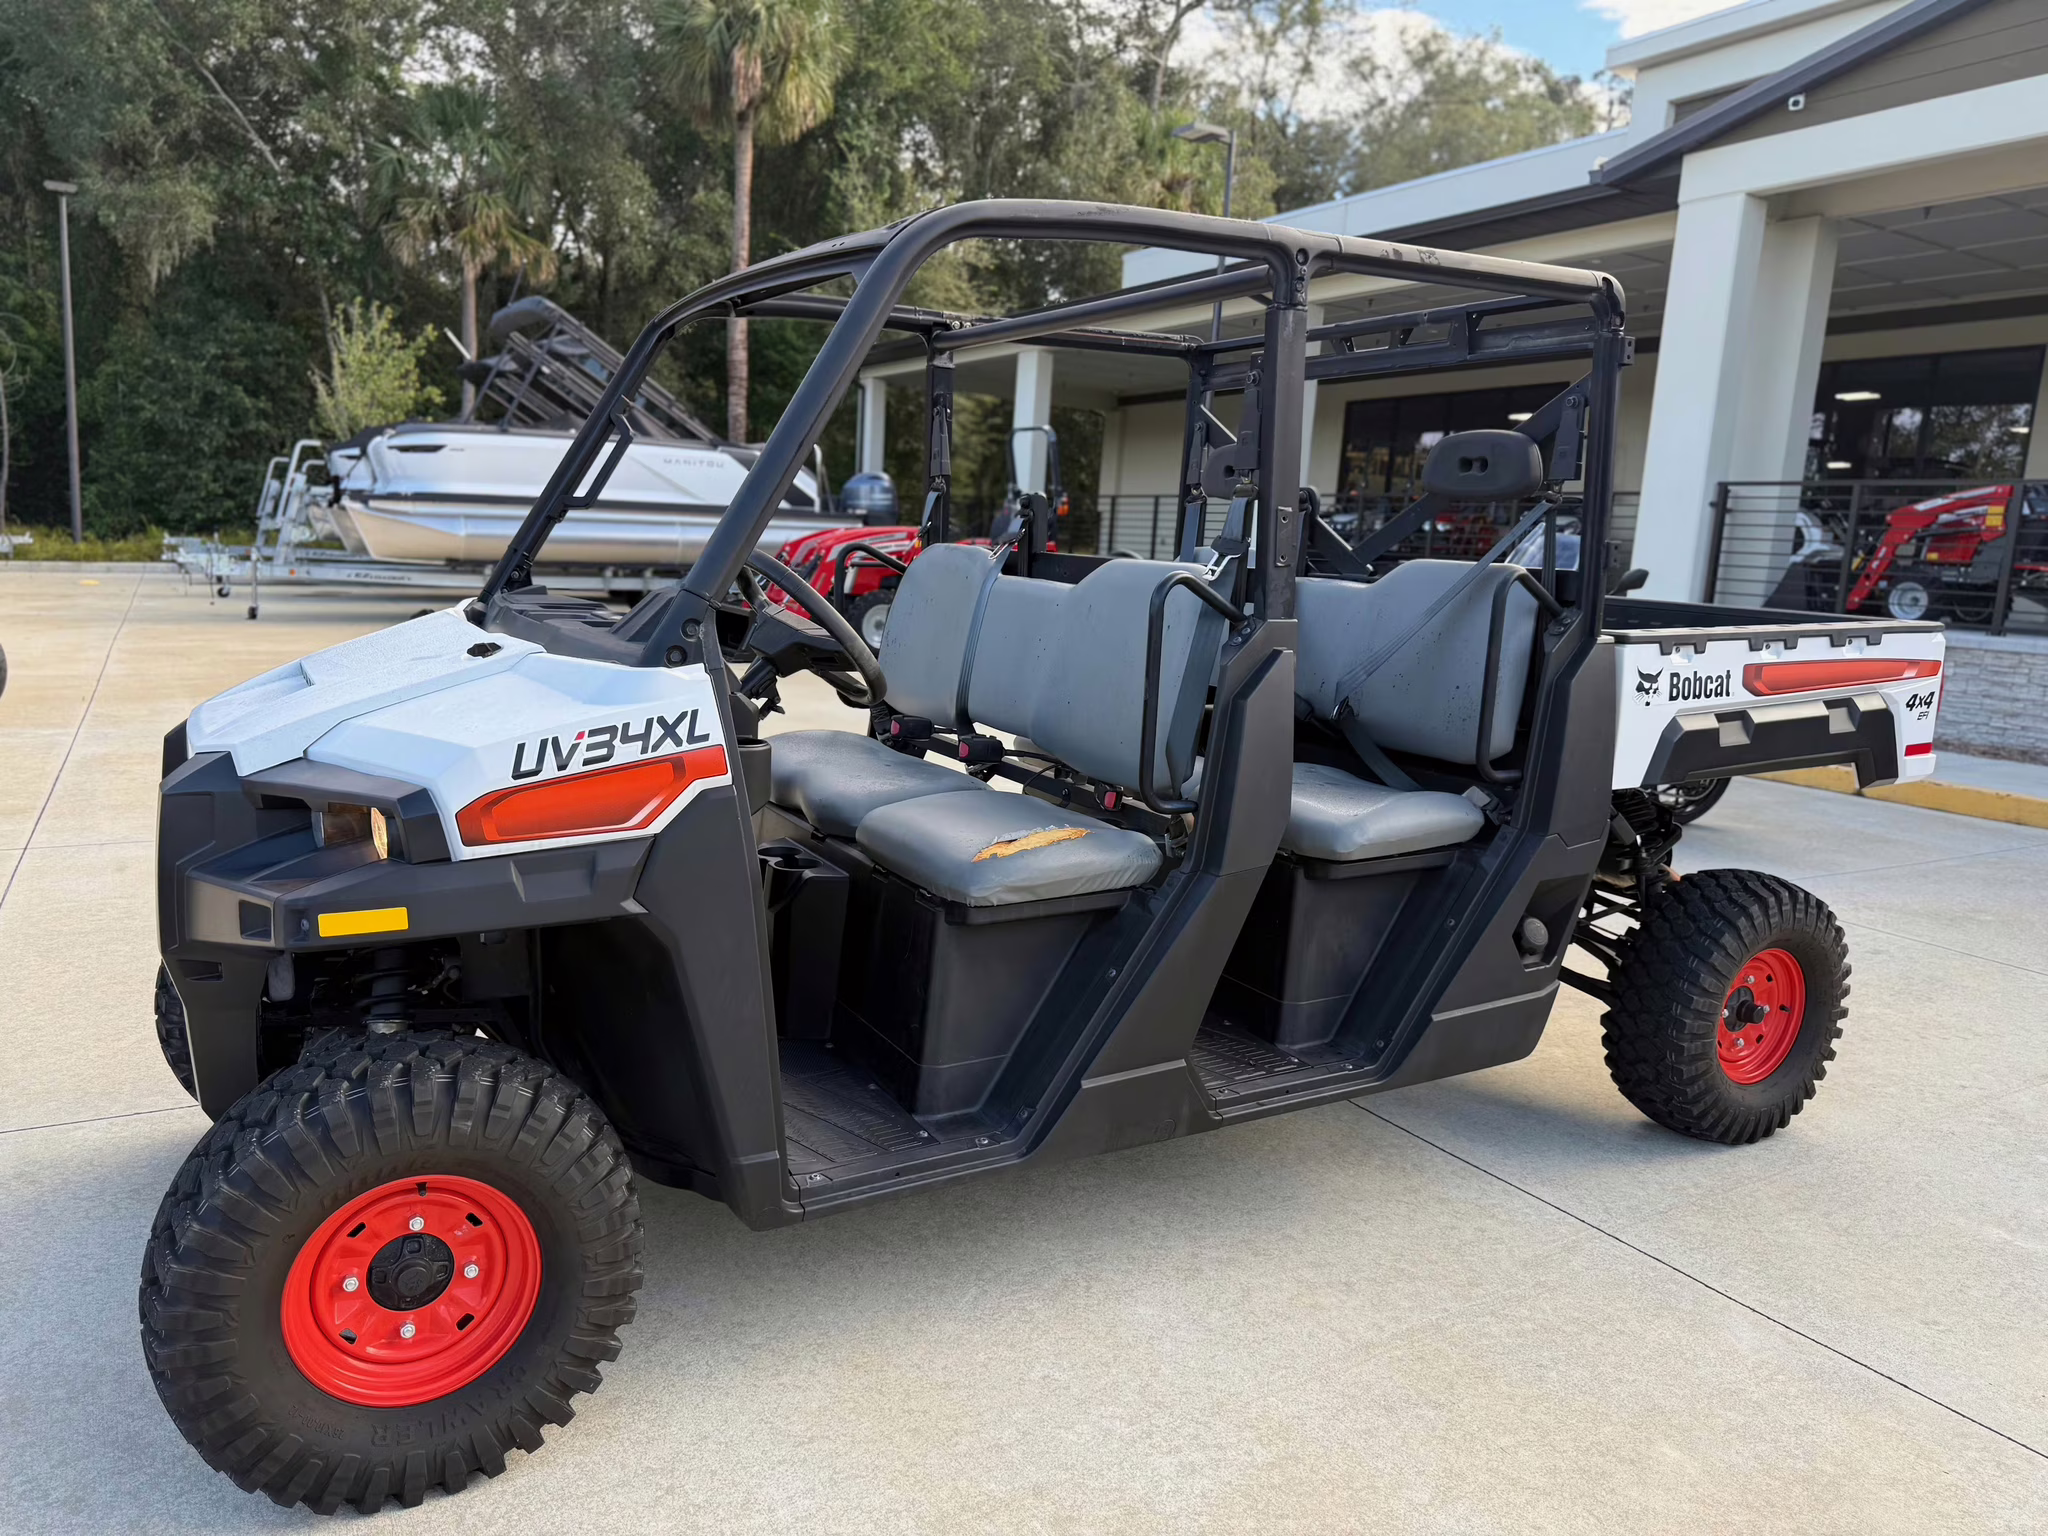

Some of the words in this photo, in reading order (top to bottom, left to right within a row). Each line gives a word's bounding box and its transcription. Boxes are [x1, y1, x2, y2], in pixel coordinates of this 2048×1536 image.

[663, 458, 724, 468] MANITOU
[1669, 669, 1731, 702] Bobcat
[1905, 691, 1935, 711] 4x4
[512, 709, 710, 780] UV34XL
